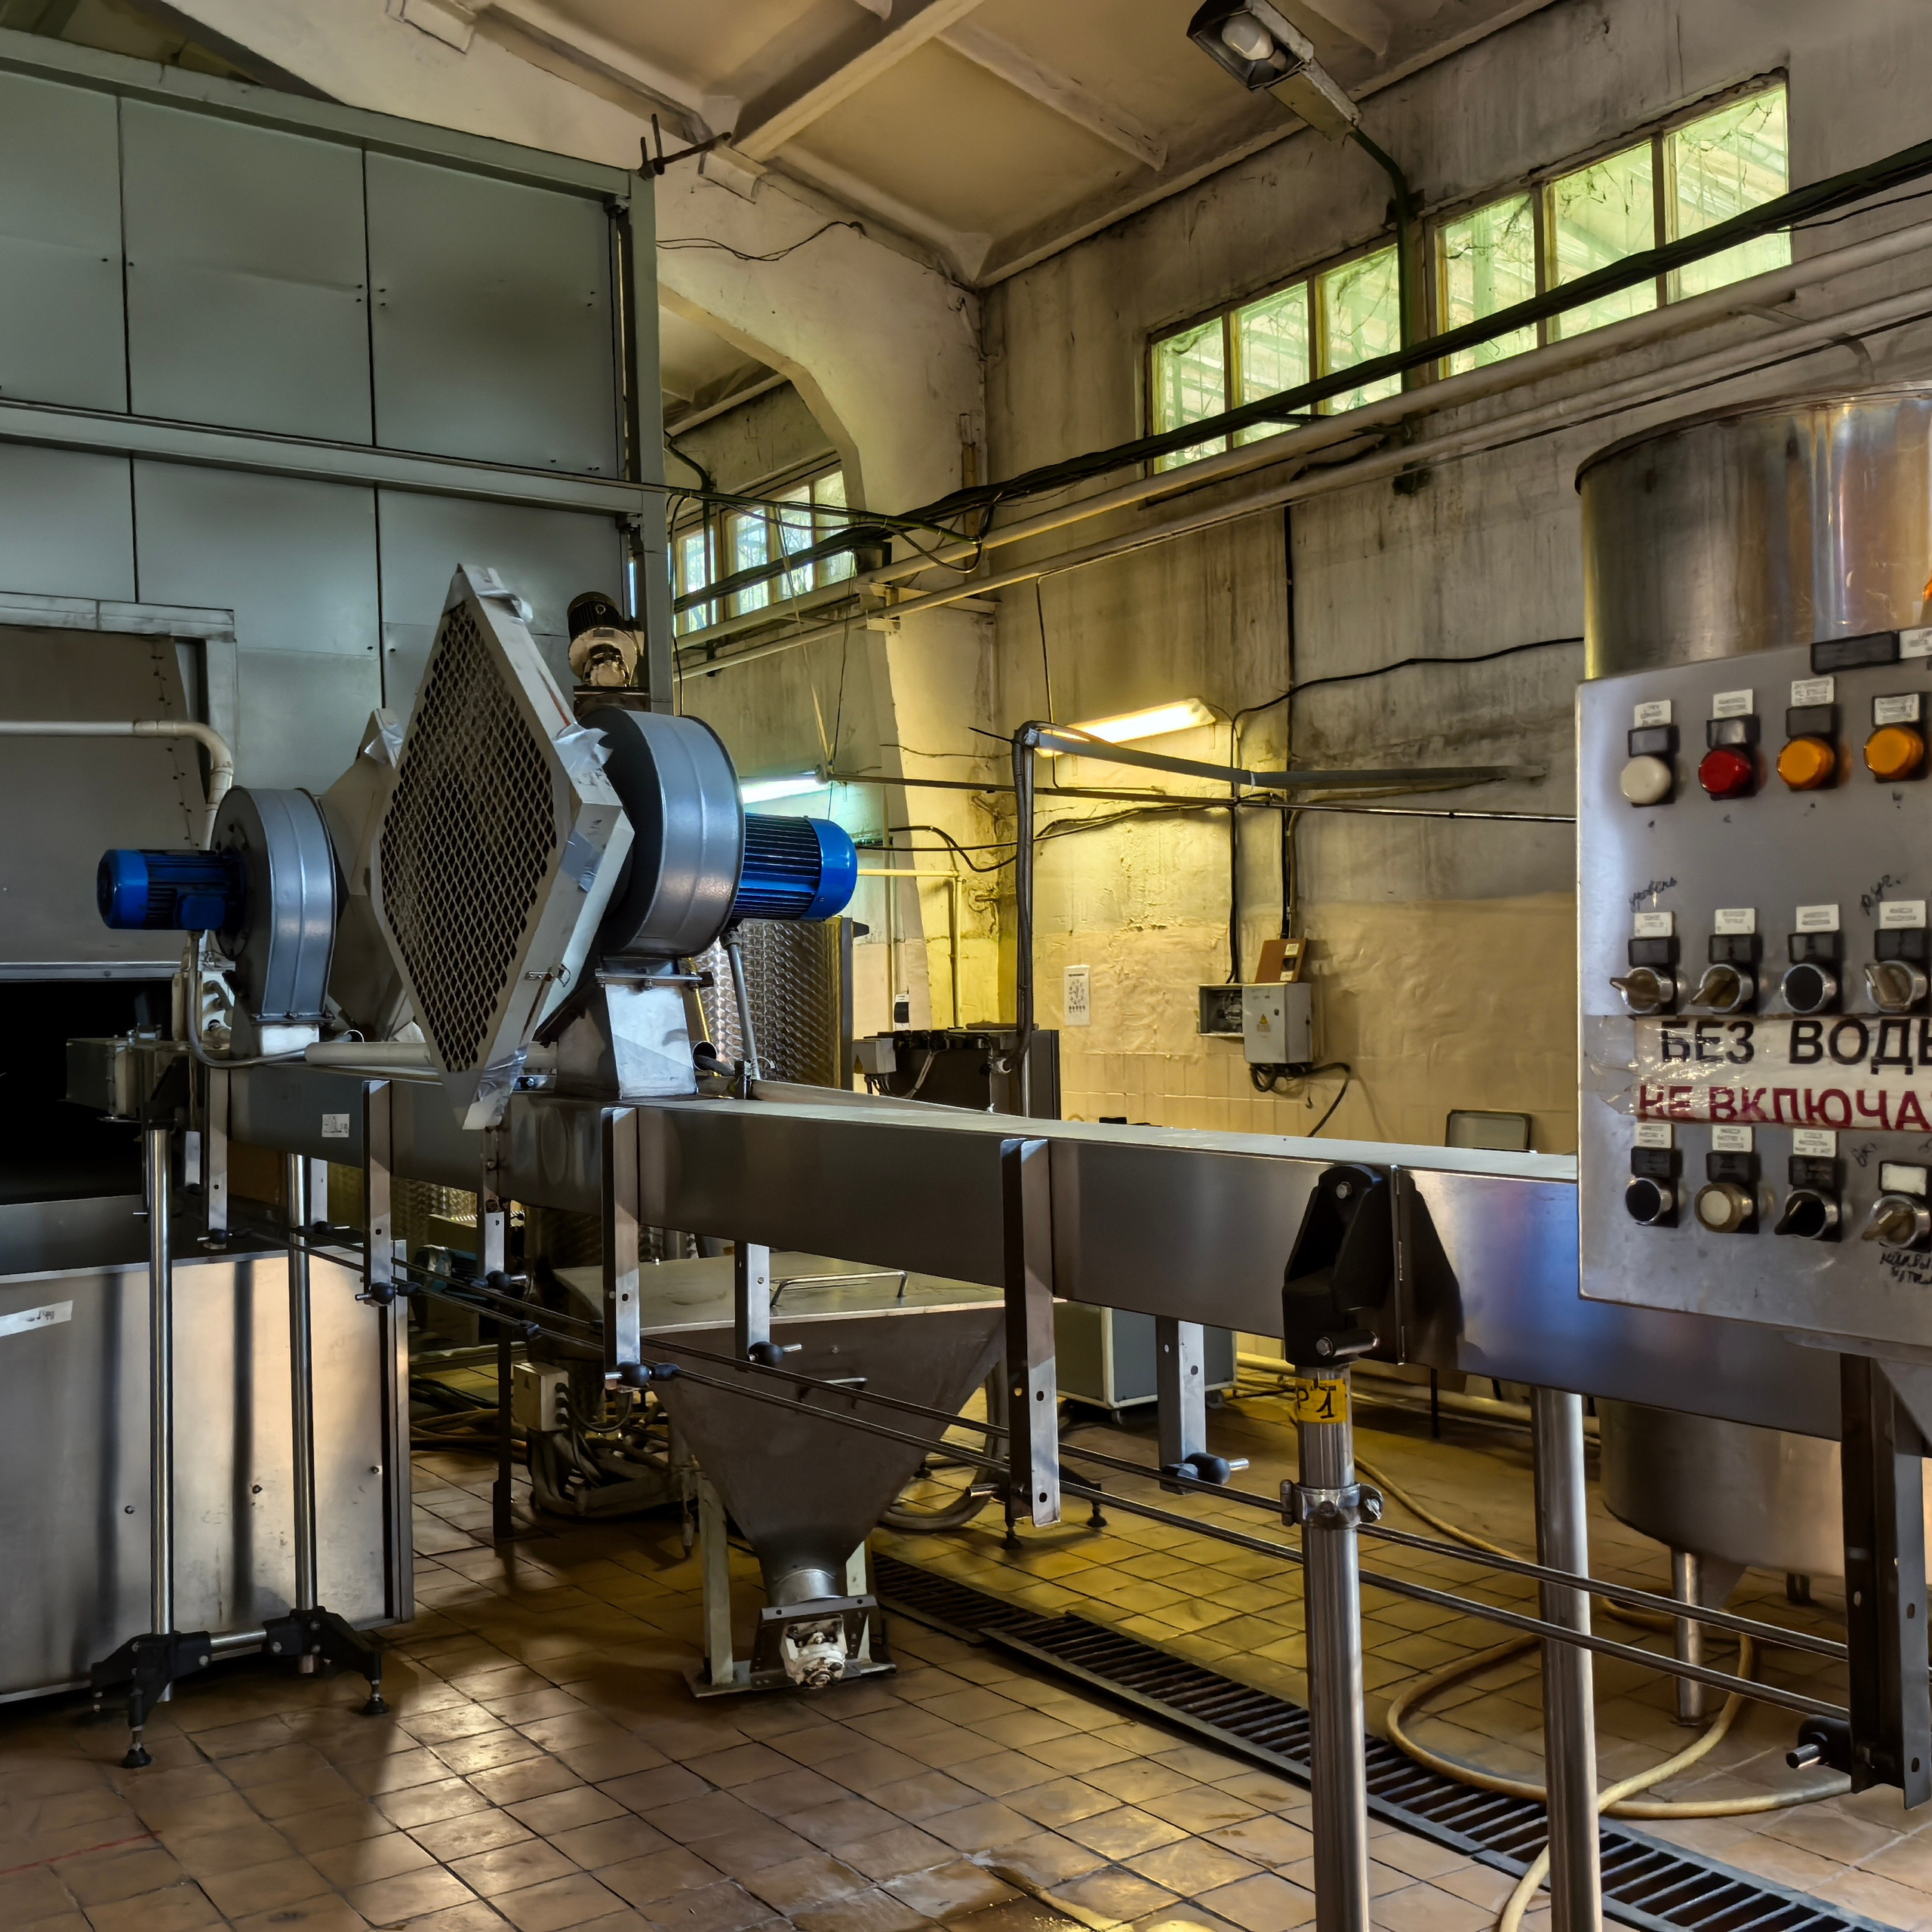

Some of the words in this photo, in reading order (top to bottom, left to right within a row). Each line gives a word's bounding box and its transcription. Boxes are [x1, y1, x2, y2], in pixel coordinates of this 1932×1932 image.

[1661, 1020, 1755, 1064] БЕЗ
[1639, 1084, 1694, 1118] НЕ
[1709, 1085, 1932, 1131] ВКЛЮЧА
